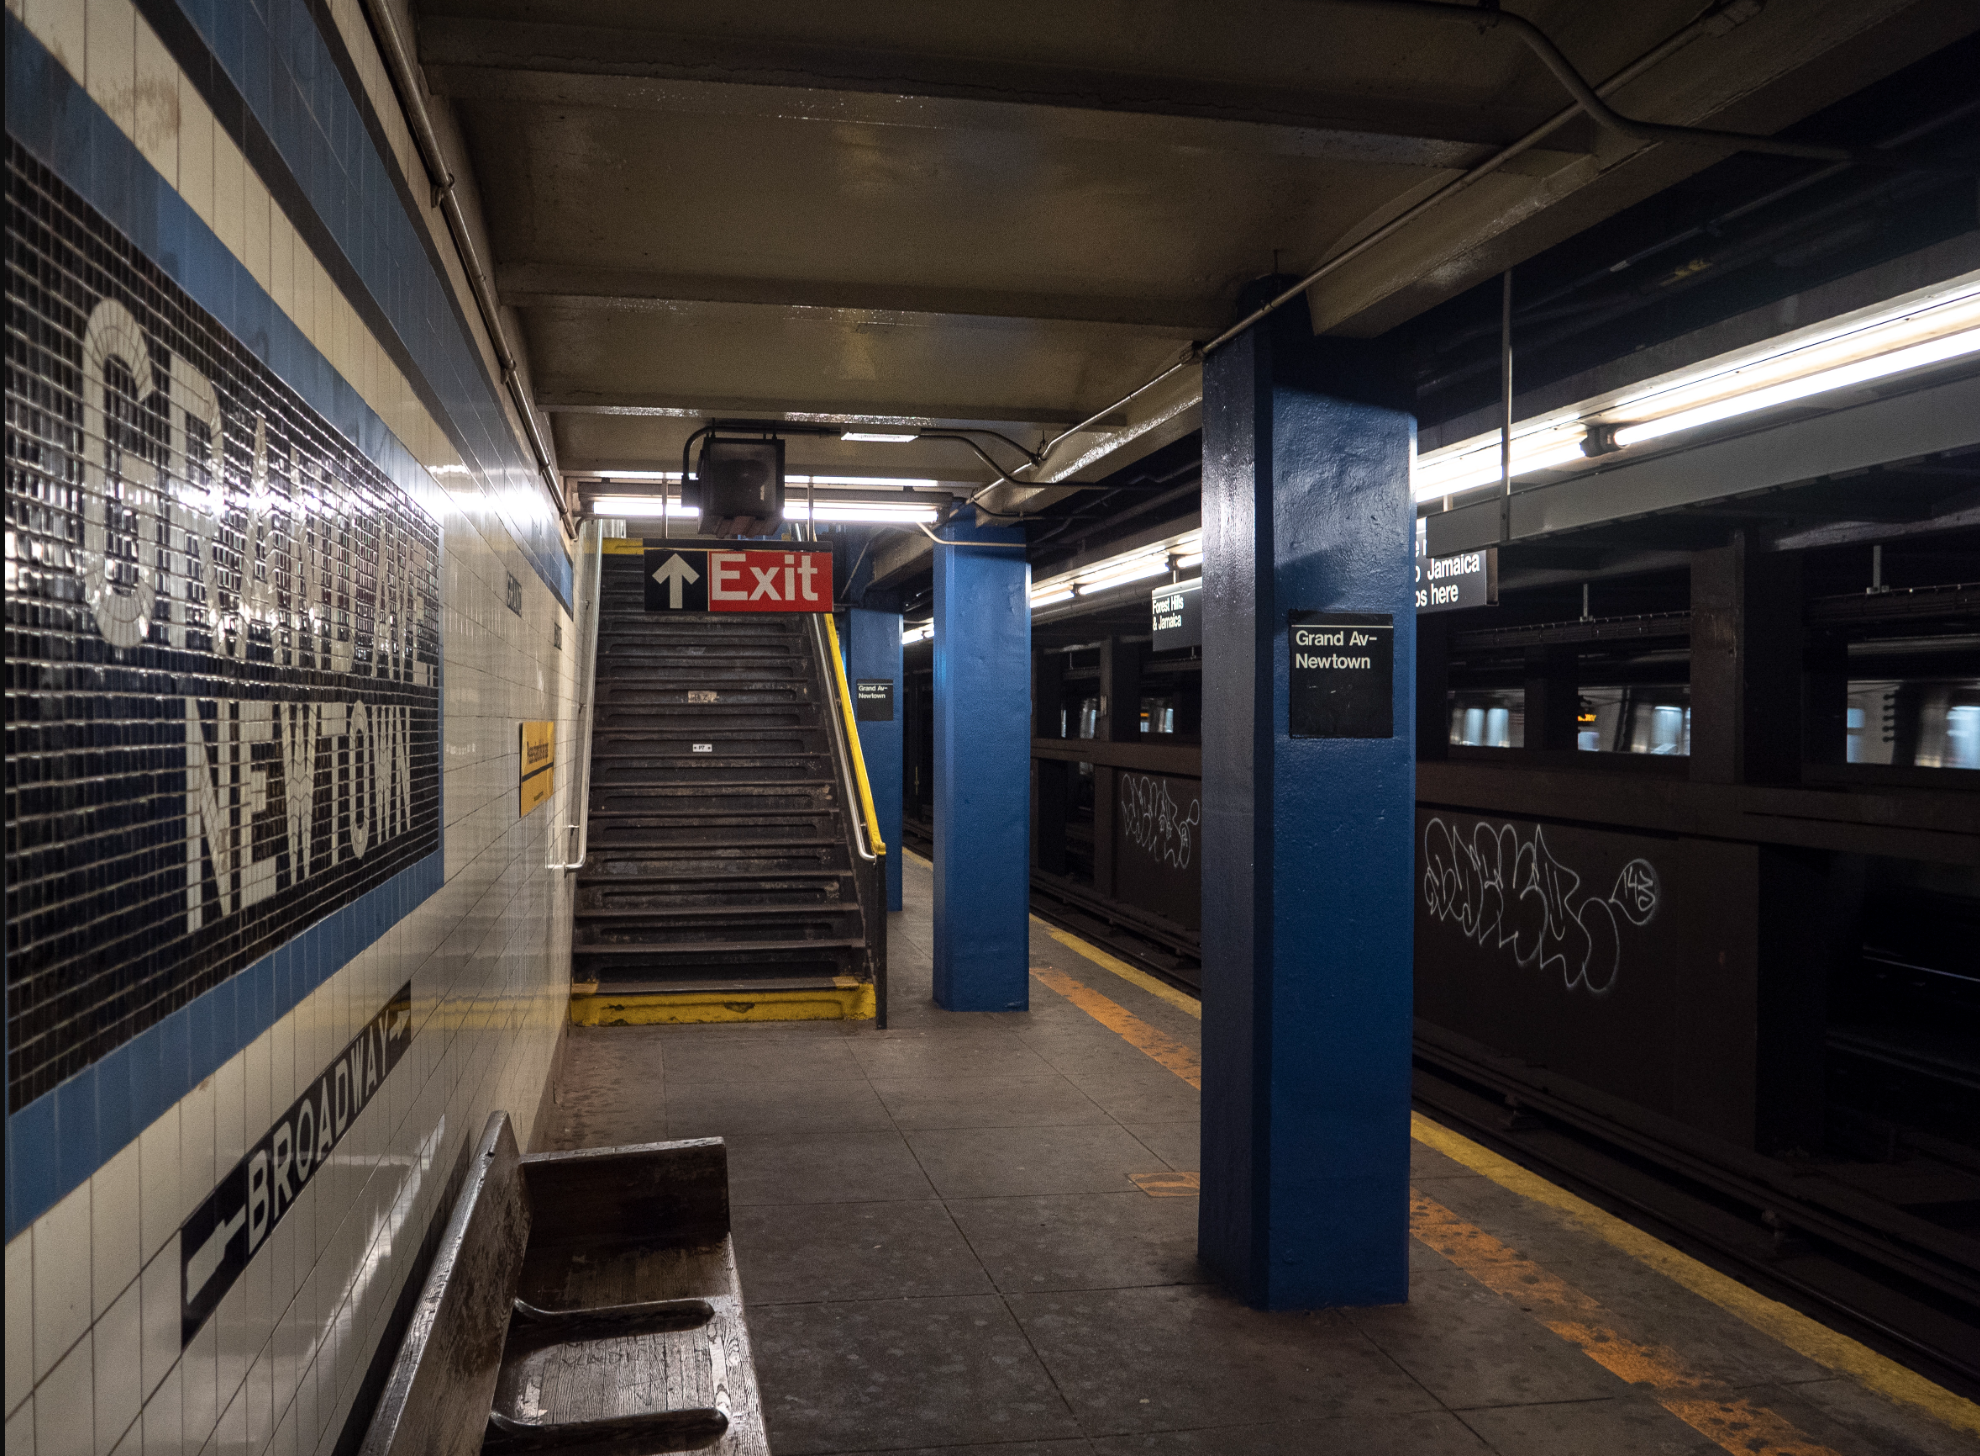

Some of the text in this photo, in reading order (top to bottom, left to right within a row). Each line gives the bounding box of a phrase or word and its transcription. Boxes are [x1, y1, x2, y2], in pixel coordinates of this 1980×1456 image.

[82, 296, 355, 674] GRAND
[711, 553, 818, 601] Exit
[1427, 554, 1480, 580] Jamaica
[1152, 594, 1184, 614] Forest Hills
[1430, 583, 1459, 605] here
[1158, 612, 1182, 630] Jamaica
[1296, 630, 1377, 646] Grand Av-
[1295, 653, 1371, 669] Newtown
[185, 697, 411, 934] NEWTOWN
[248, 1009, 392, 1255] BROADWAY
